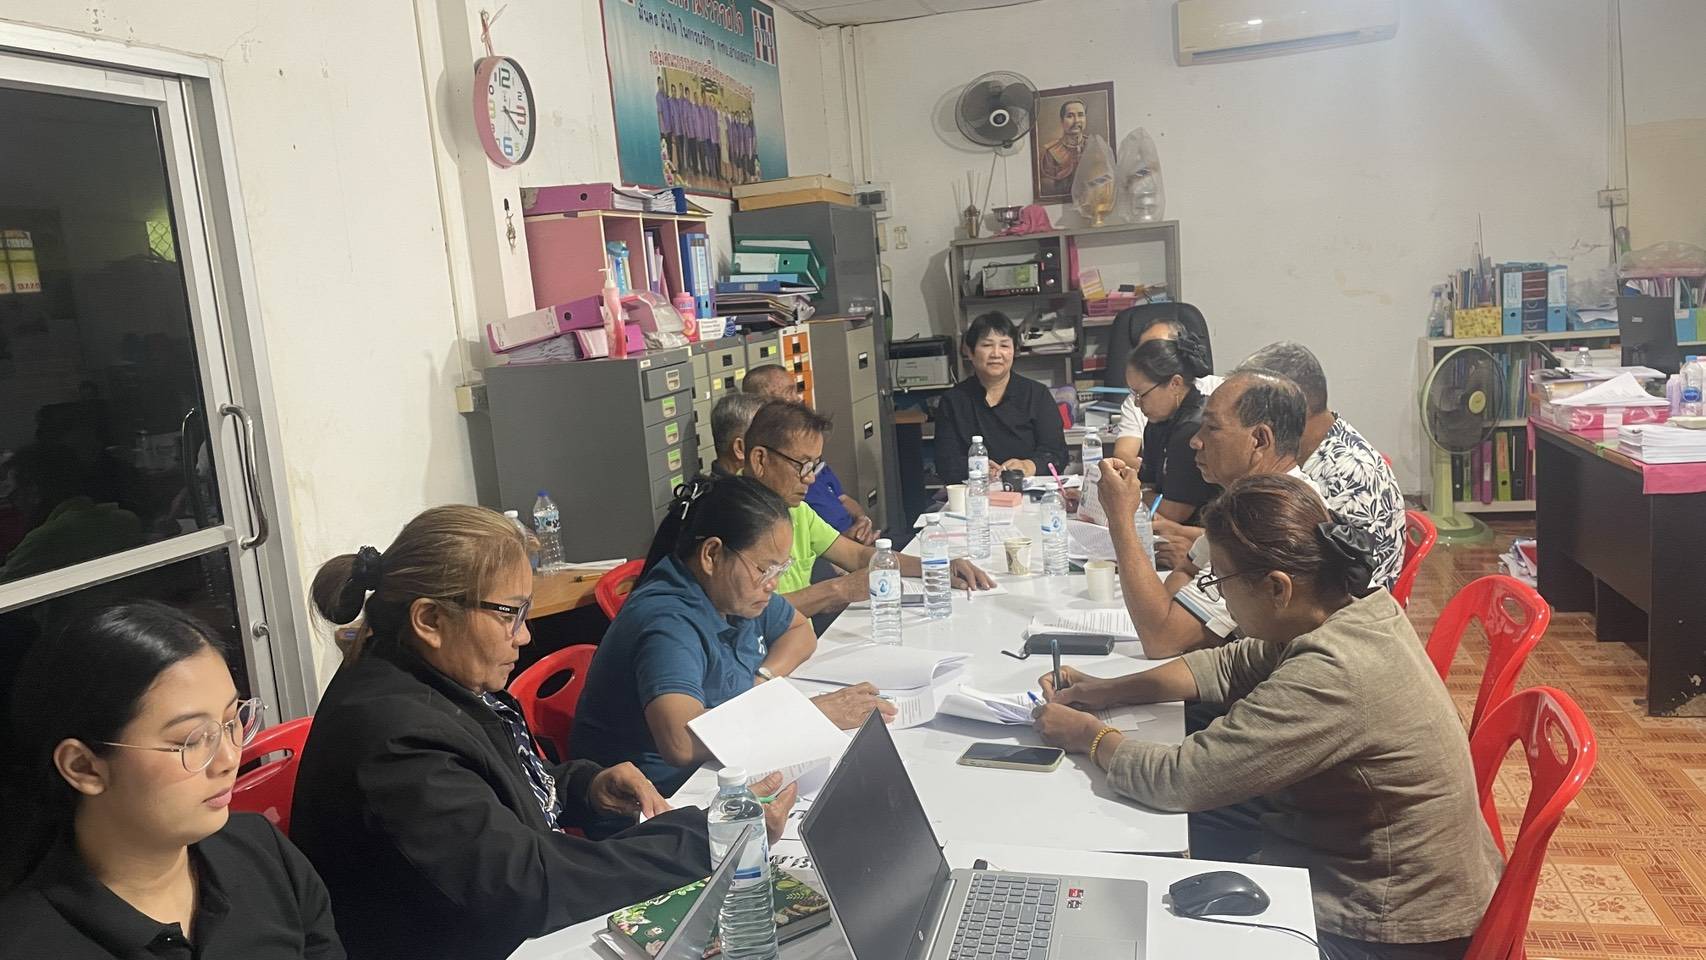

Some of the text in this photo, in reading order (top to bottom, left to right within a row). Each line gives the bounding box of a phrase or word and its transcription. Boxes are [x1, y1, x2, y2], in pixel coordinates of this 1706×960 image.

[499, 67, 511, 88] 12
[516, 105, 526, 125] 3
[503, 136, 513, 156] 6
